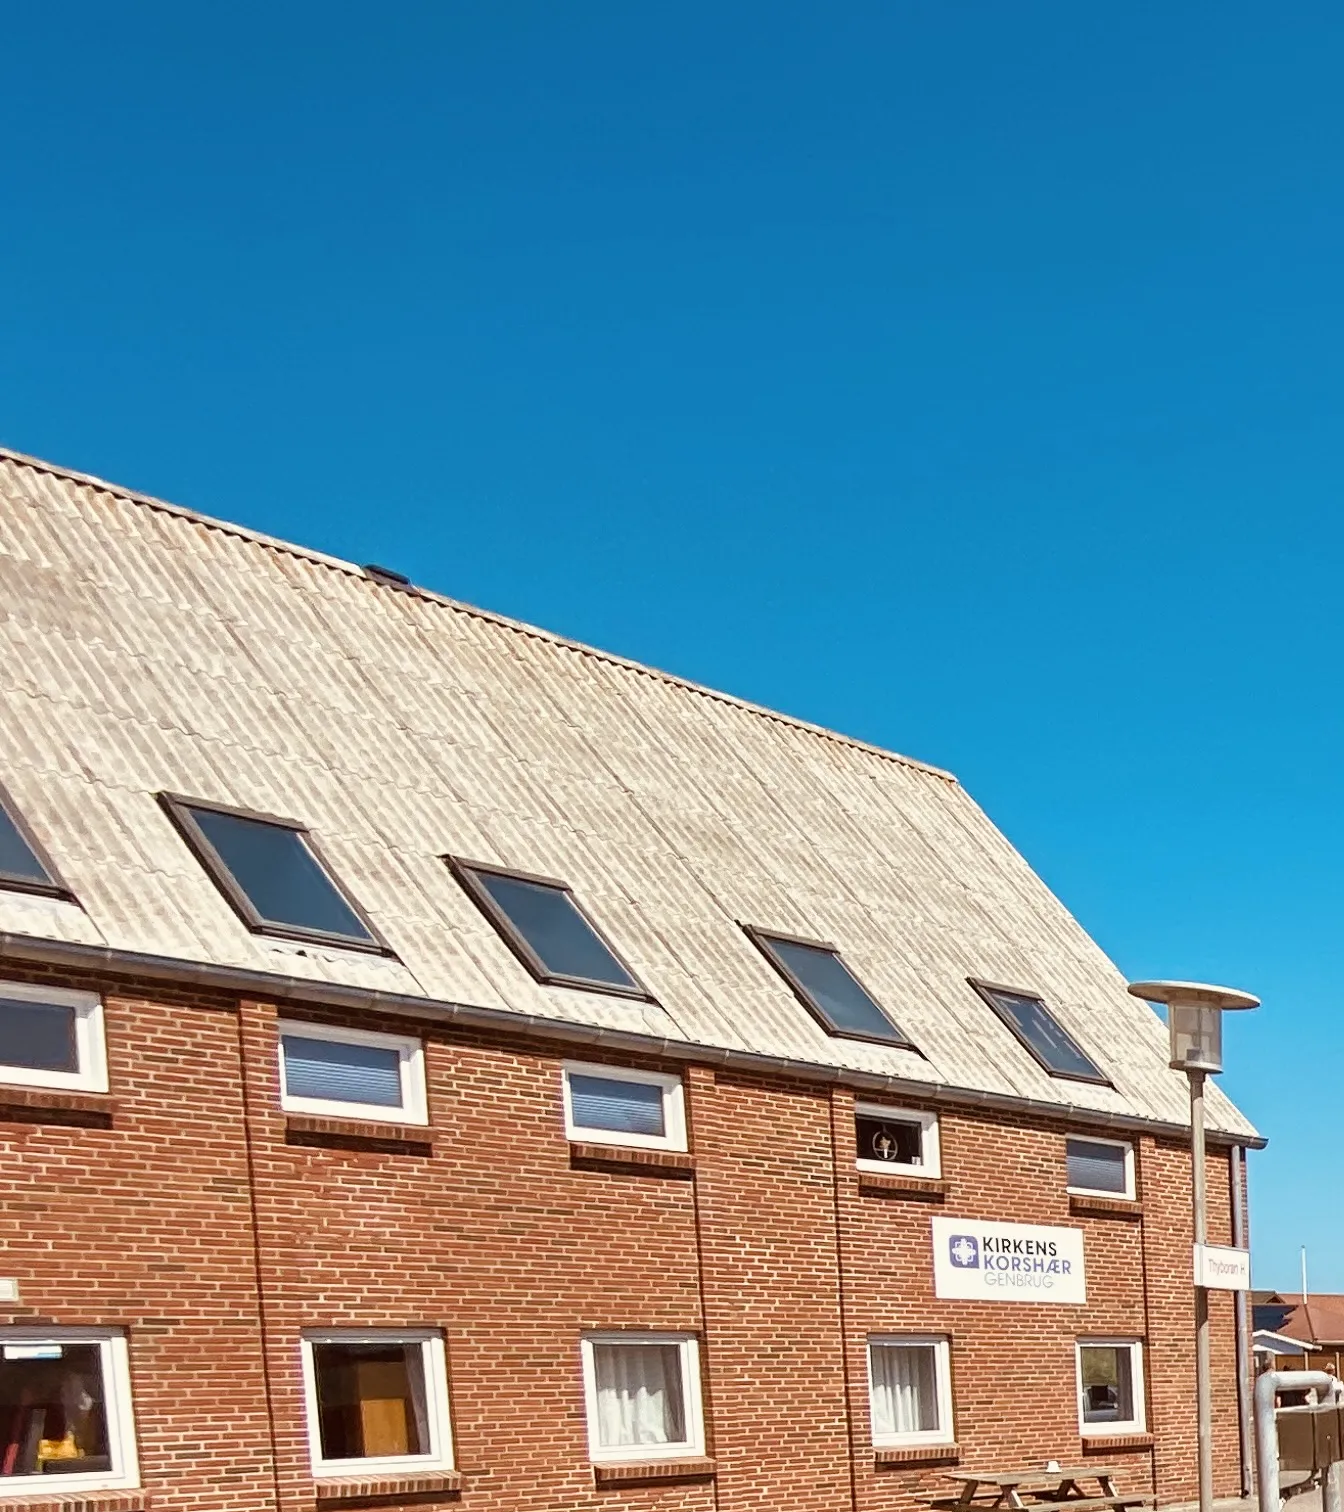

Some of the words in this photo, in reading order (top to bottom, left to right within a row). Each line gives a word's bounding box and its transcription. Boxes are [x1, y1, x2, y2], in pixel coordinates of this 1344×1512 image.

[982, 1236, 1057, 1257] KIRKENS
[983, 1254, 1072, 1275] KORSHÆR
[984, 1271, 1055, 1289] GENBRUG
